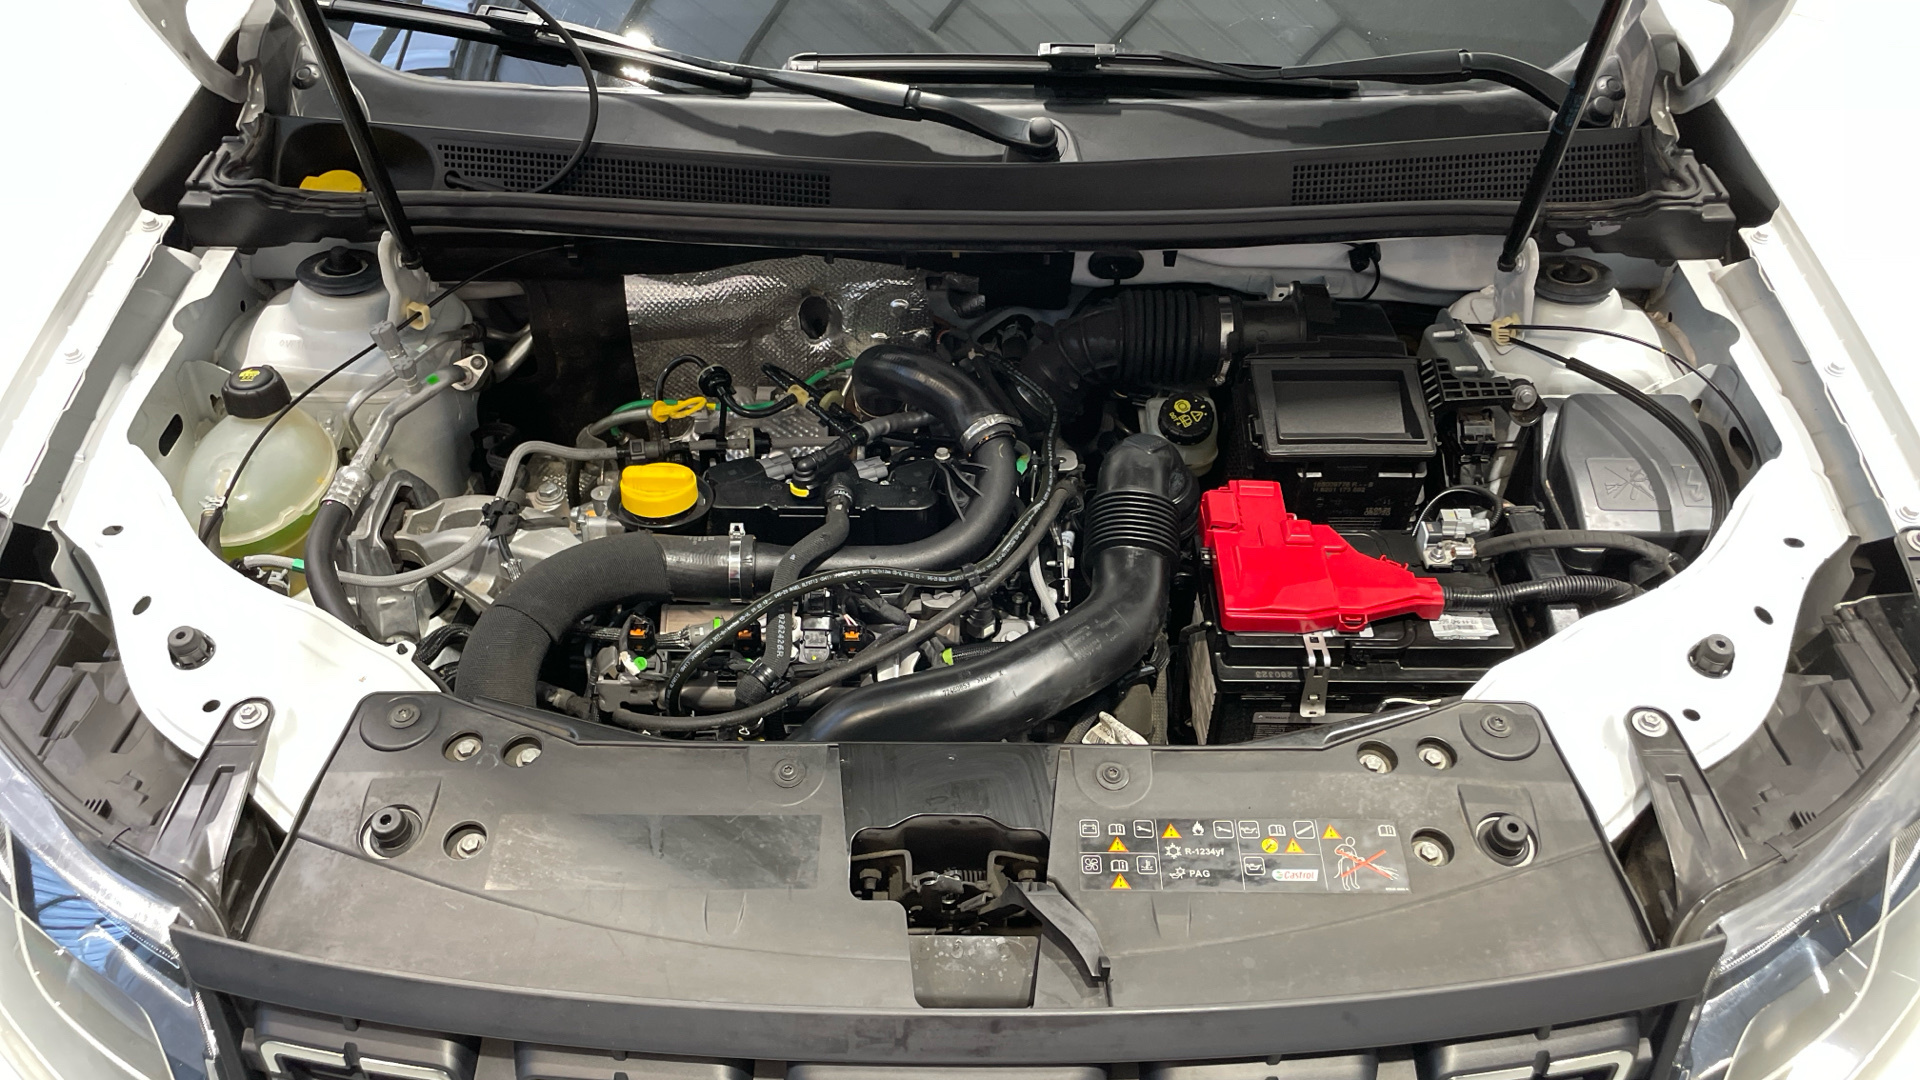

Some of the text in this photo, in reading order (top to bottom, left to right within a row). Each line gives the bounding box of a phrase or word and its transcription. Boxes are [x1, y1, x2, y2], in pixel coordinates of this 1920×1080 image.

[1184, 848, 1225, 857] R-1234yf
[1189, 869, 1211, 878] PAG
[1284, 870, 1315, 880] Castrol
